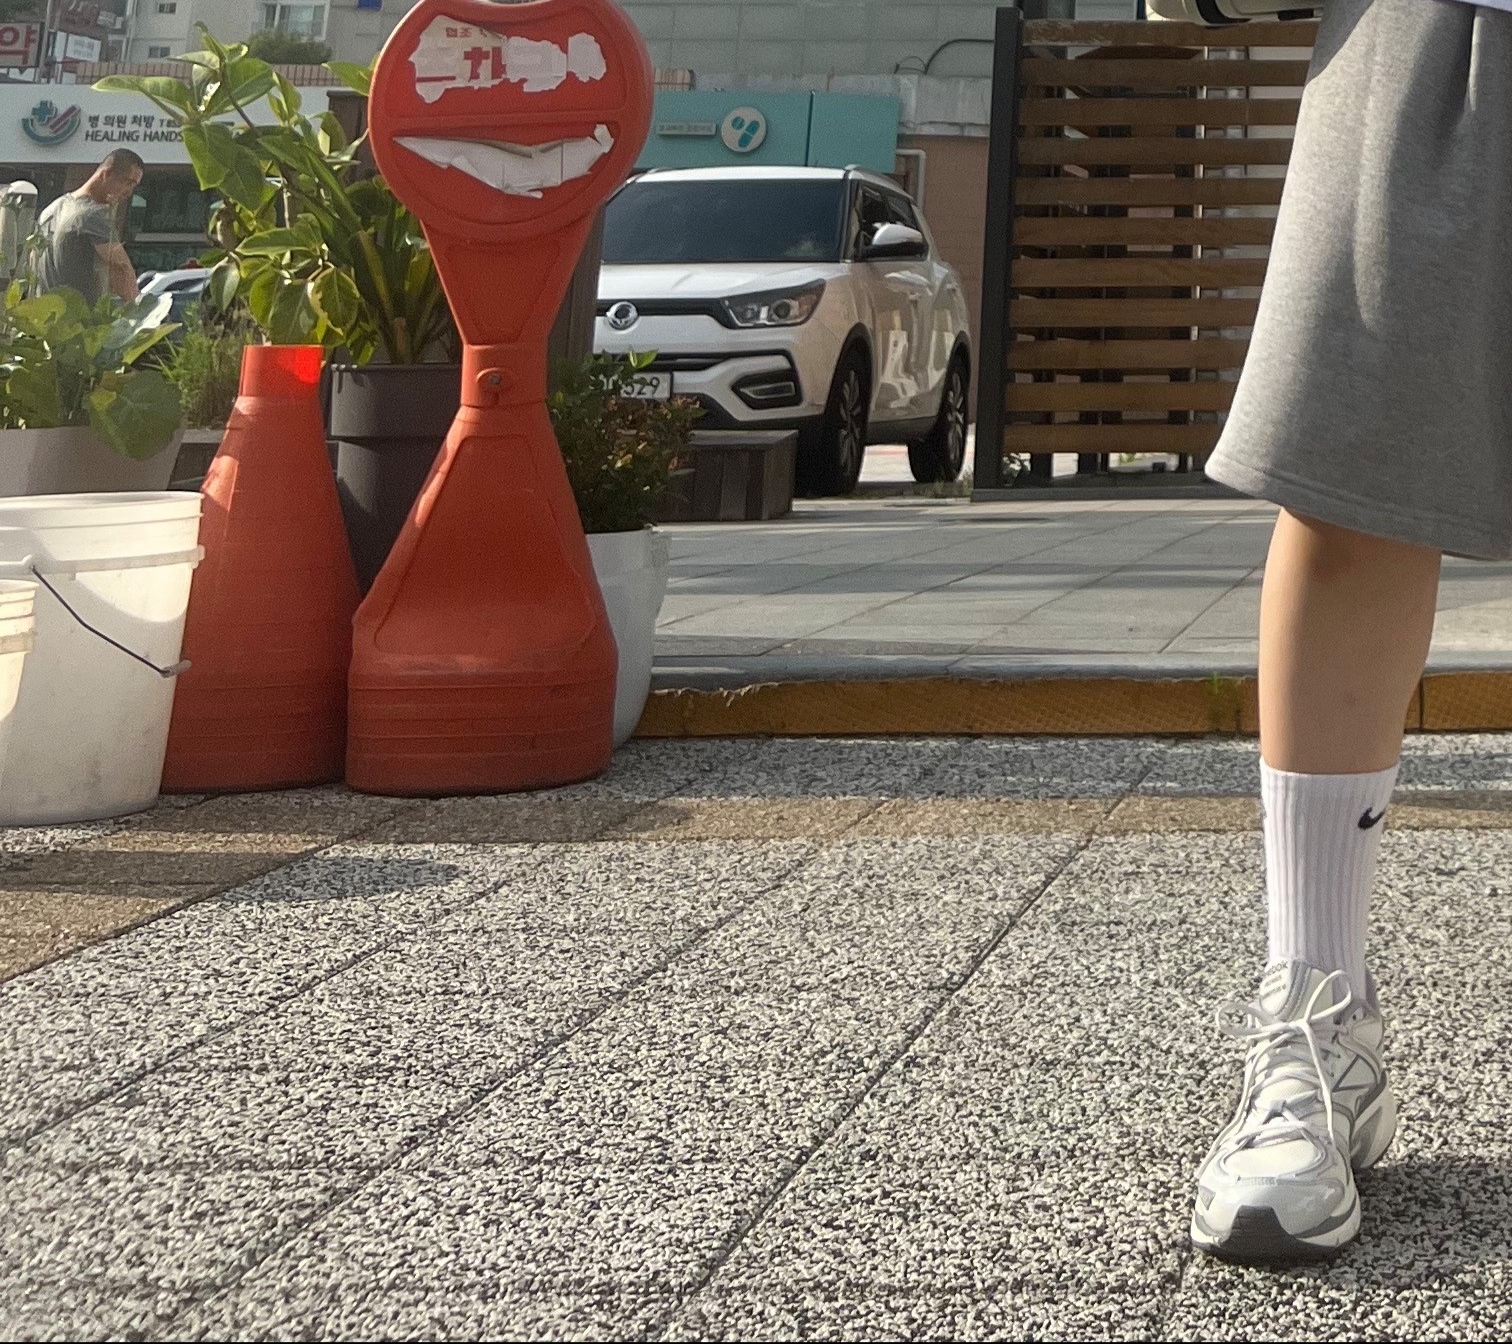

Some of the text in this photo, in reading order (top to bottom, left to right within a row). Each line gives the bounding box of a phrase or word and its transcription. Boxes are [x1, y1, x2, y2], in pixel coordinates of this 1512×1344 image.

[0, 24, 38, 65] 약
[84, 129, 184, 143] HEALING HANDS
